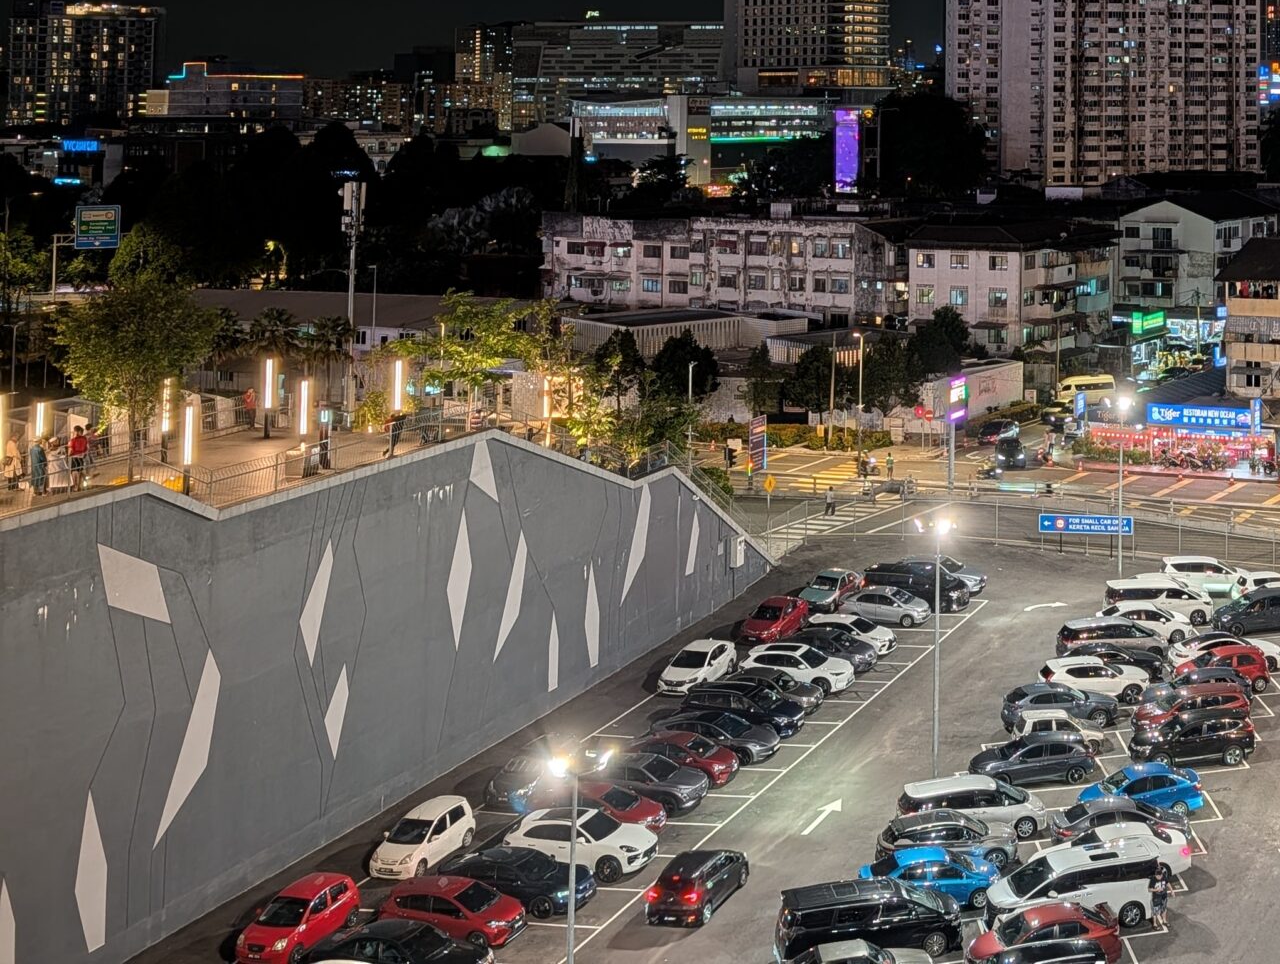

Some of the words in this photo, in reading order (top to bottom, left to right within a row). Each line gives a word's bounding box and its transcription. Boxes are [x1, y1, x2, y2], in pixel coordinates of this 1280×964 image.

[1160, 408, 1181, 420] Tiger
[1183, 408, 1207, 417] RESTORAN
[1208, 409, 1219, 418] NEW
[1220, 410, 1235, 419] OCEAN
